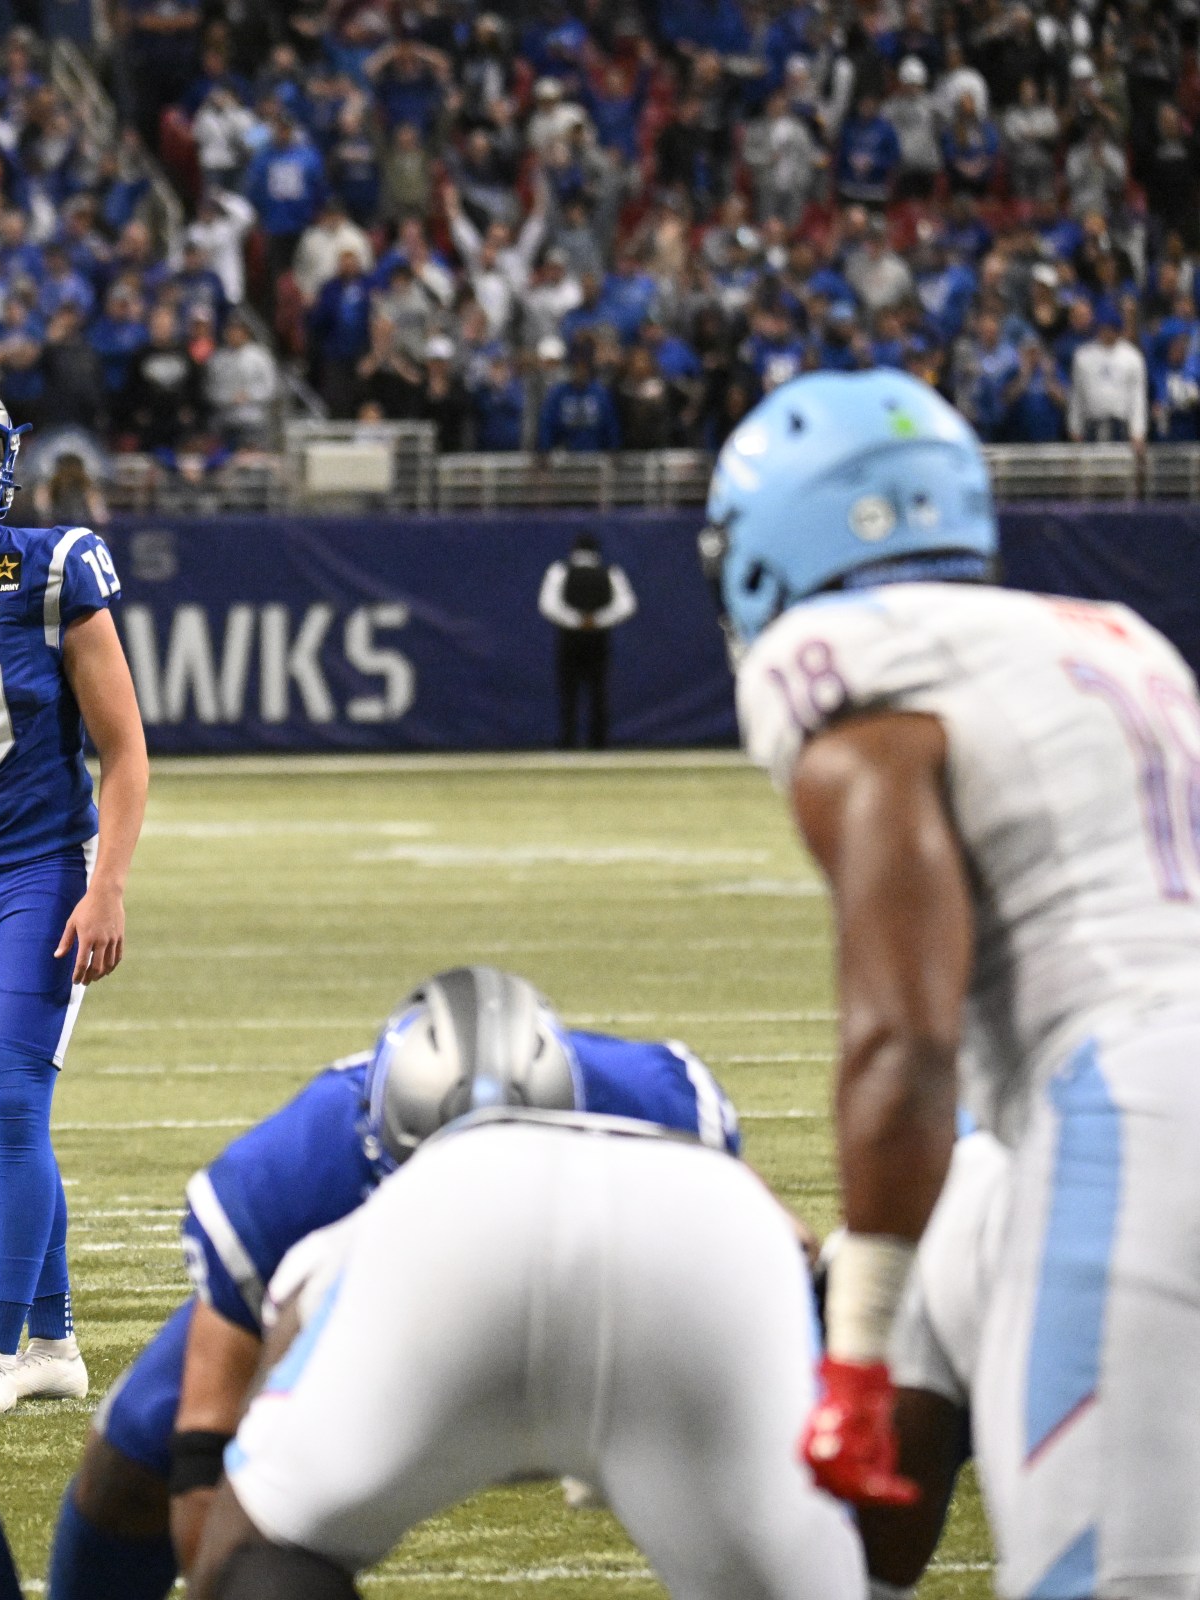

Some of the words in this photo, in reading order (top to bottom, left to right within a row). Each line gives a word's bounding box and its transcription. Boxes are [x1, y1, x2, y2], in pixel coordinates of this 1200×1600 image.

[0, 583, 20, 592] ARMY
[80, 544, 121, 599] 19
[766, 638, 848, 744] 18
